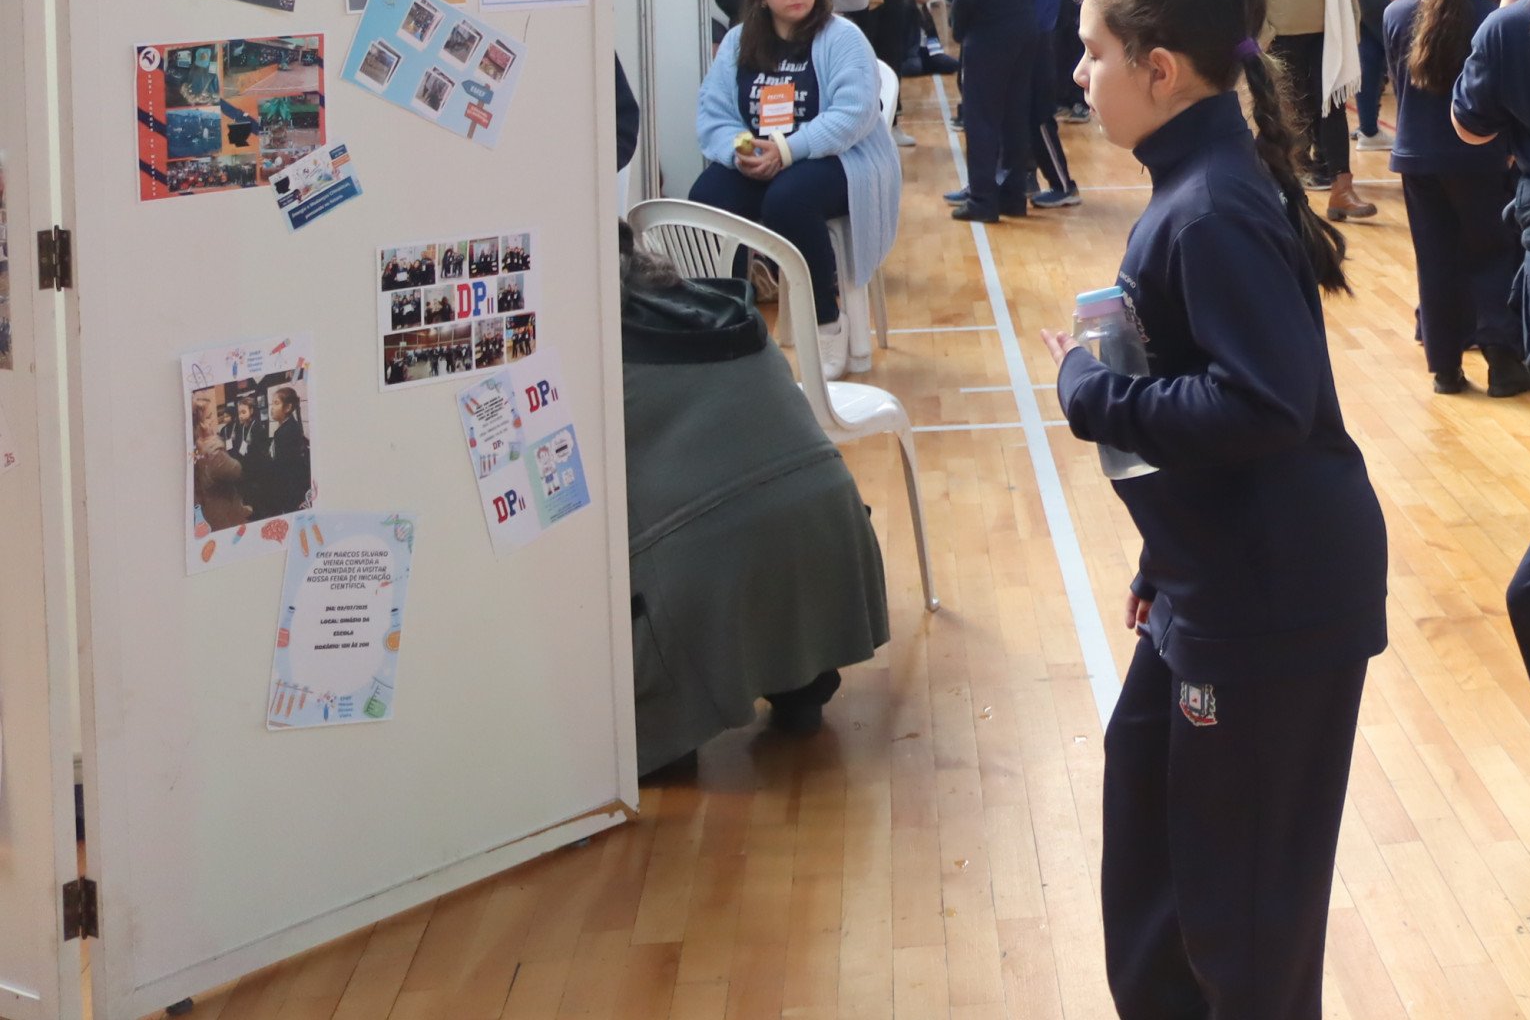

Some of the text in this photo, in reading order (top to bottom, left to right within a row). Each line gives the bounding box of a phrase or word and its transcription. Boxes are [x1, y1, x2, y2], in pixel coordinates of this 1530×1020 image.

[457, 281, 487, 319] DP
[525, 380, 550, 413] DP
[493, 489, 518, 524] DP
[359, 574, 391, 582] INICIAÇÃO
